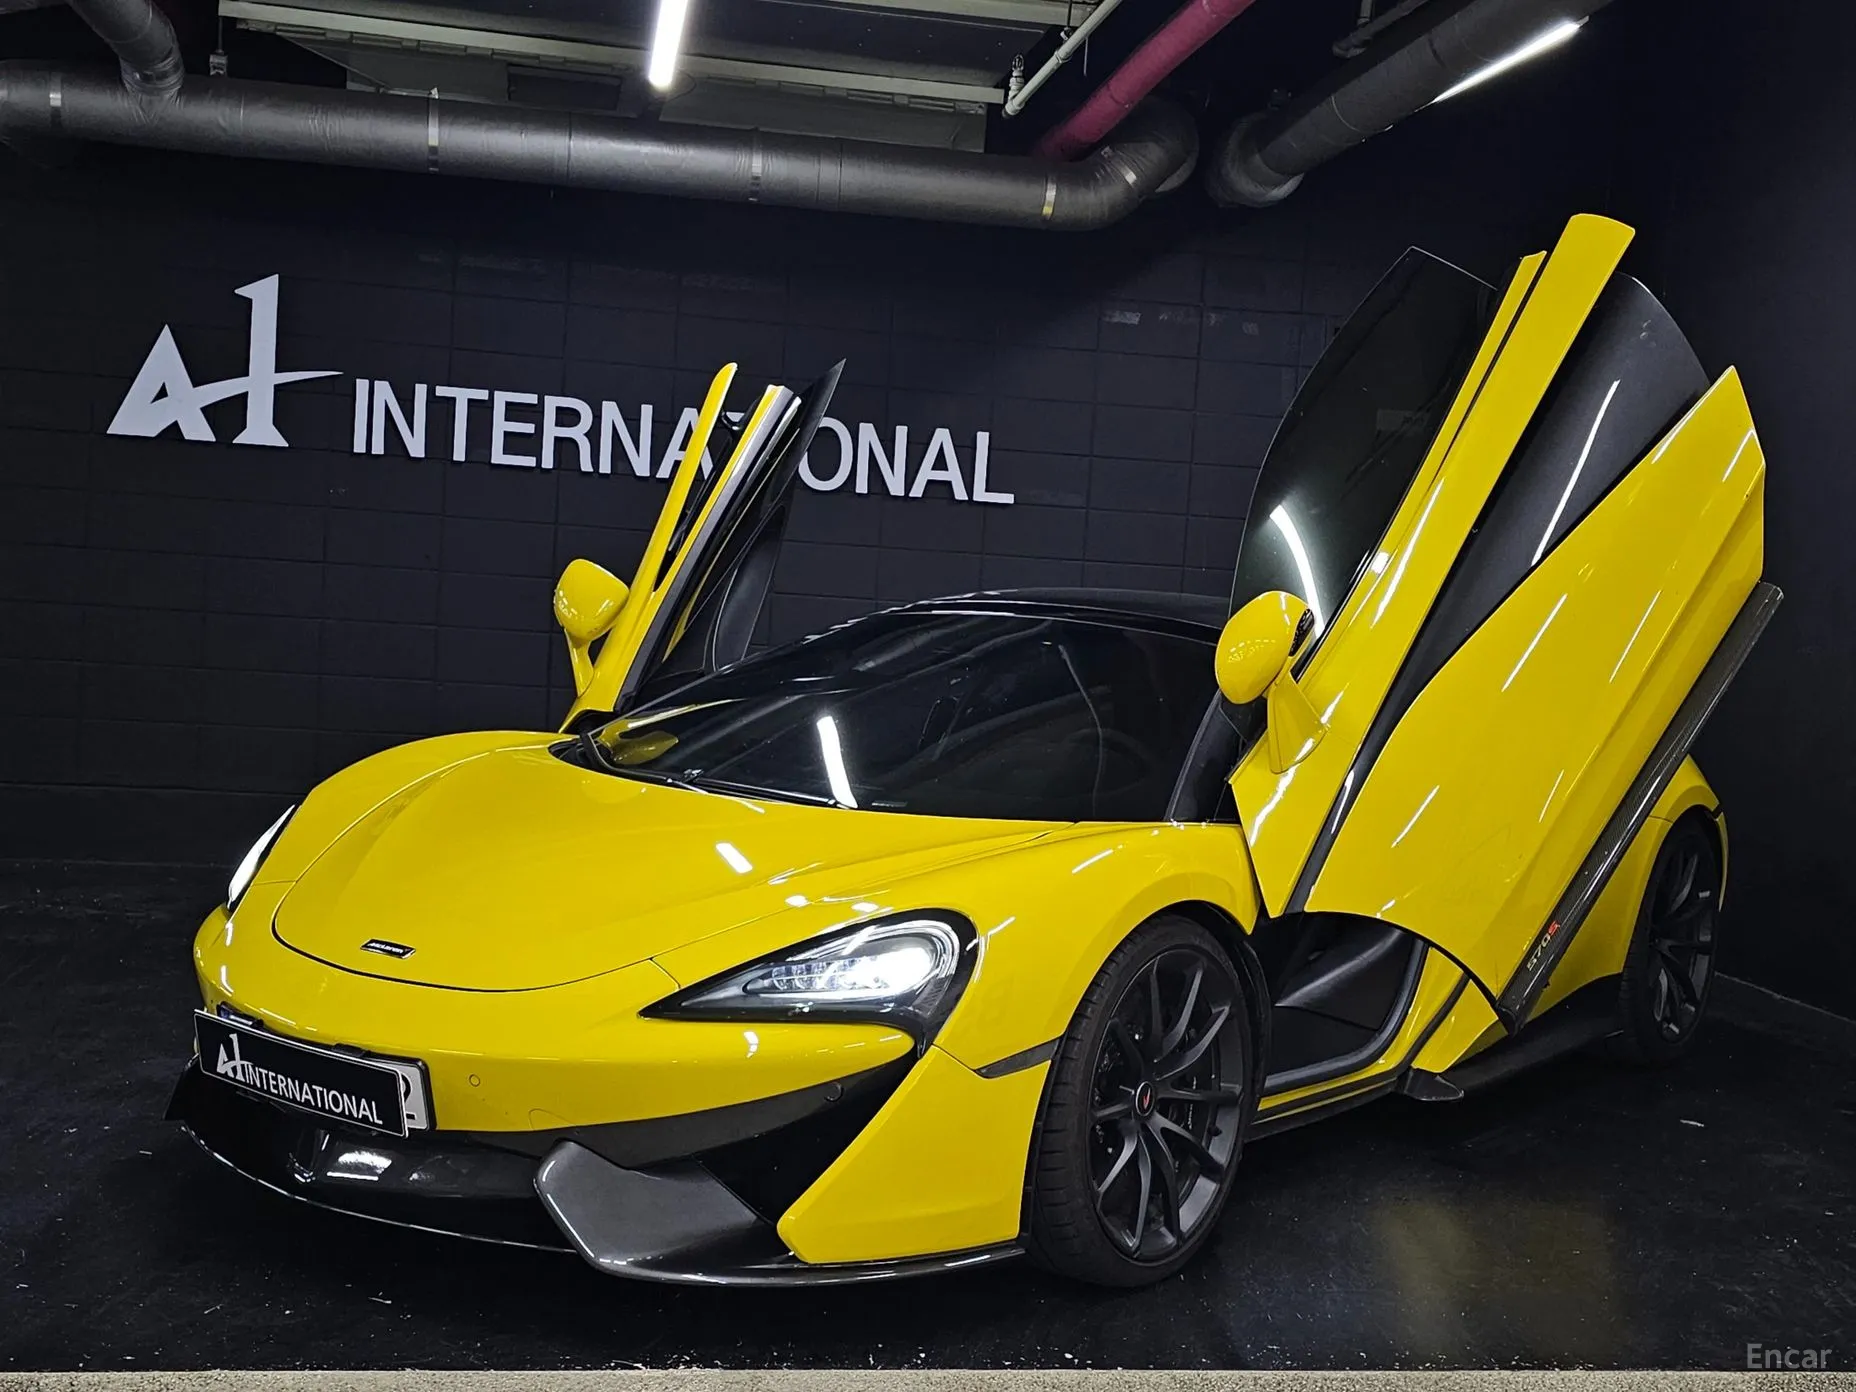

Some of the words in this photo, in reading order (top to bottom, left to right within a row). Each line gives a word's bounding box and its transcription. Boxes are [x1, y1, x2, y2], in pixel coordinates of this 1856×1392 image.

[106, 274, 344, 447] A1
[353, 378, 1015, 504] INTERNAONAL
[1526, 920, 1561, 972] 570S
[244, 1064, 383, 1125] INTERNATIONAL
